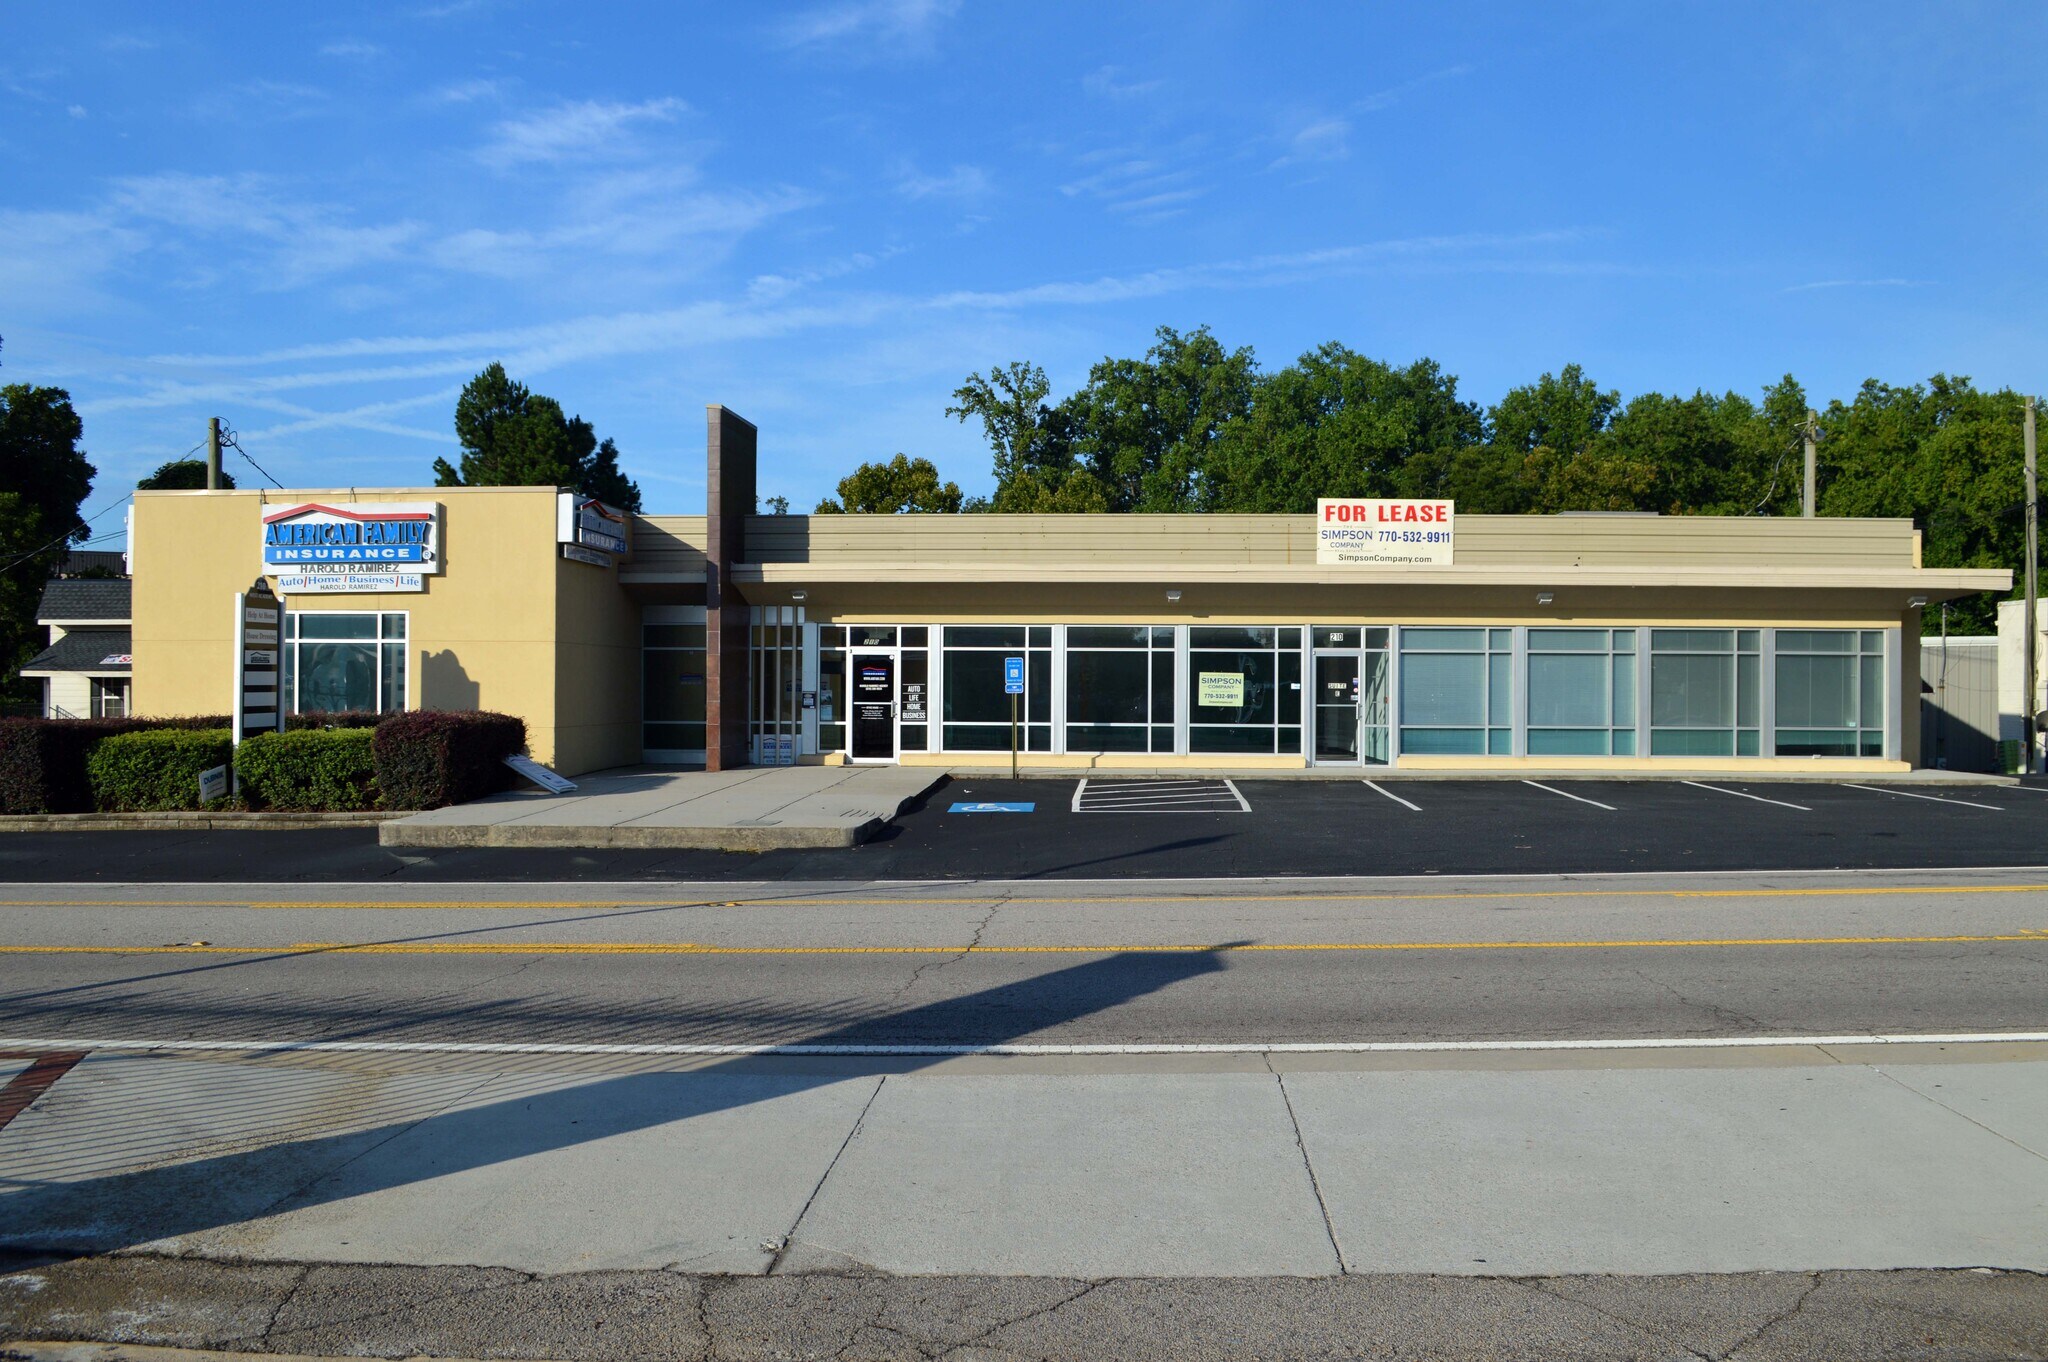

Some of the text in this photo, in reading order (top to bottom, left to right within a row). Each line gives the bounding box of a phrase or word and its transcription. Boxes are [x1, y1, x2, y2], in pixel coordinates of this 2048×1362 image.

[1325, 505, 1447, 522] FOR LEASE
[265, 522, 426, 545] AMERICAN FAMILY
[1321, 530, 1373, 540] SIMPSON
[1378, 531, 1450, 543] 770-532-9911
[1330, 541, 1364, 549] COMPANY
[276, 548, 410, 560] INSURANCE
[1338, 554, 1432, 563] SimpsonCompany.com
[300, 562, 400, 574] HAROLD RAMIREZ
